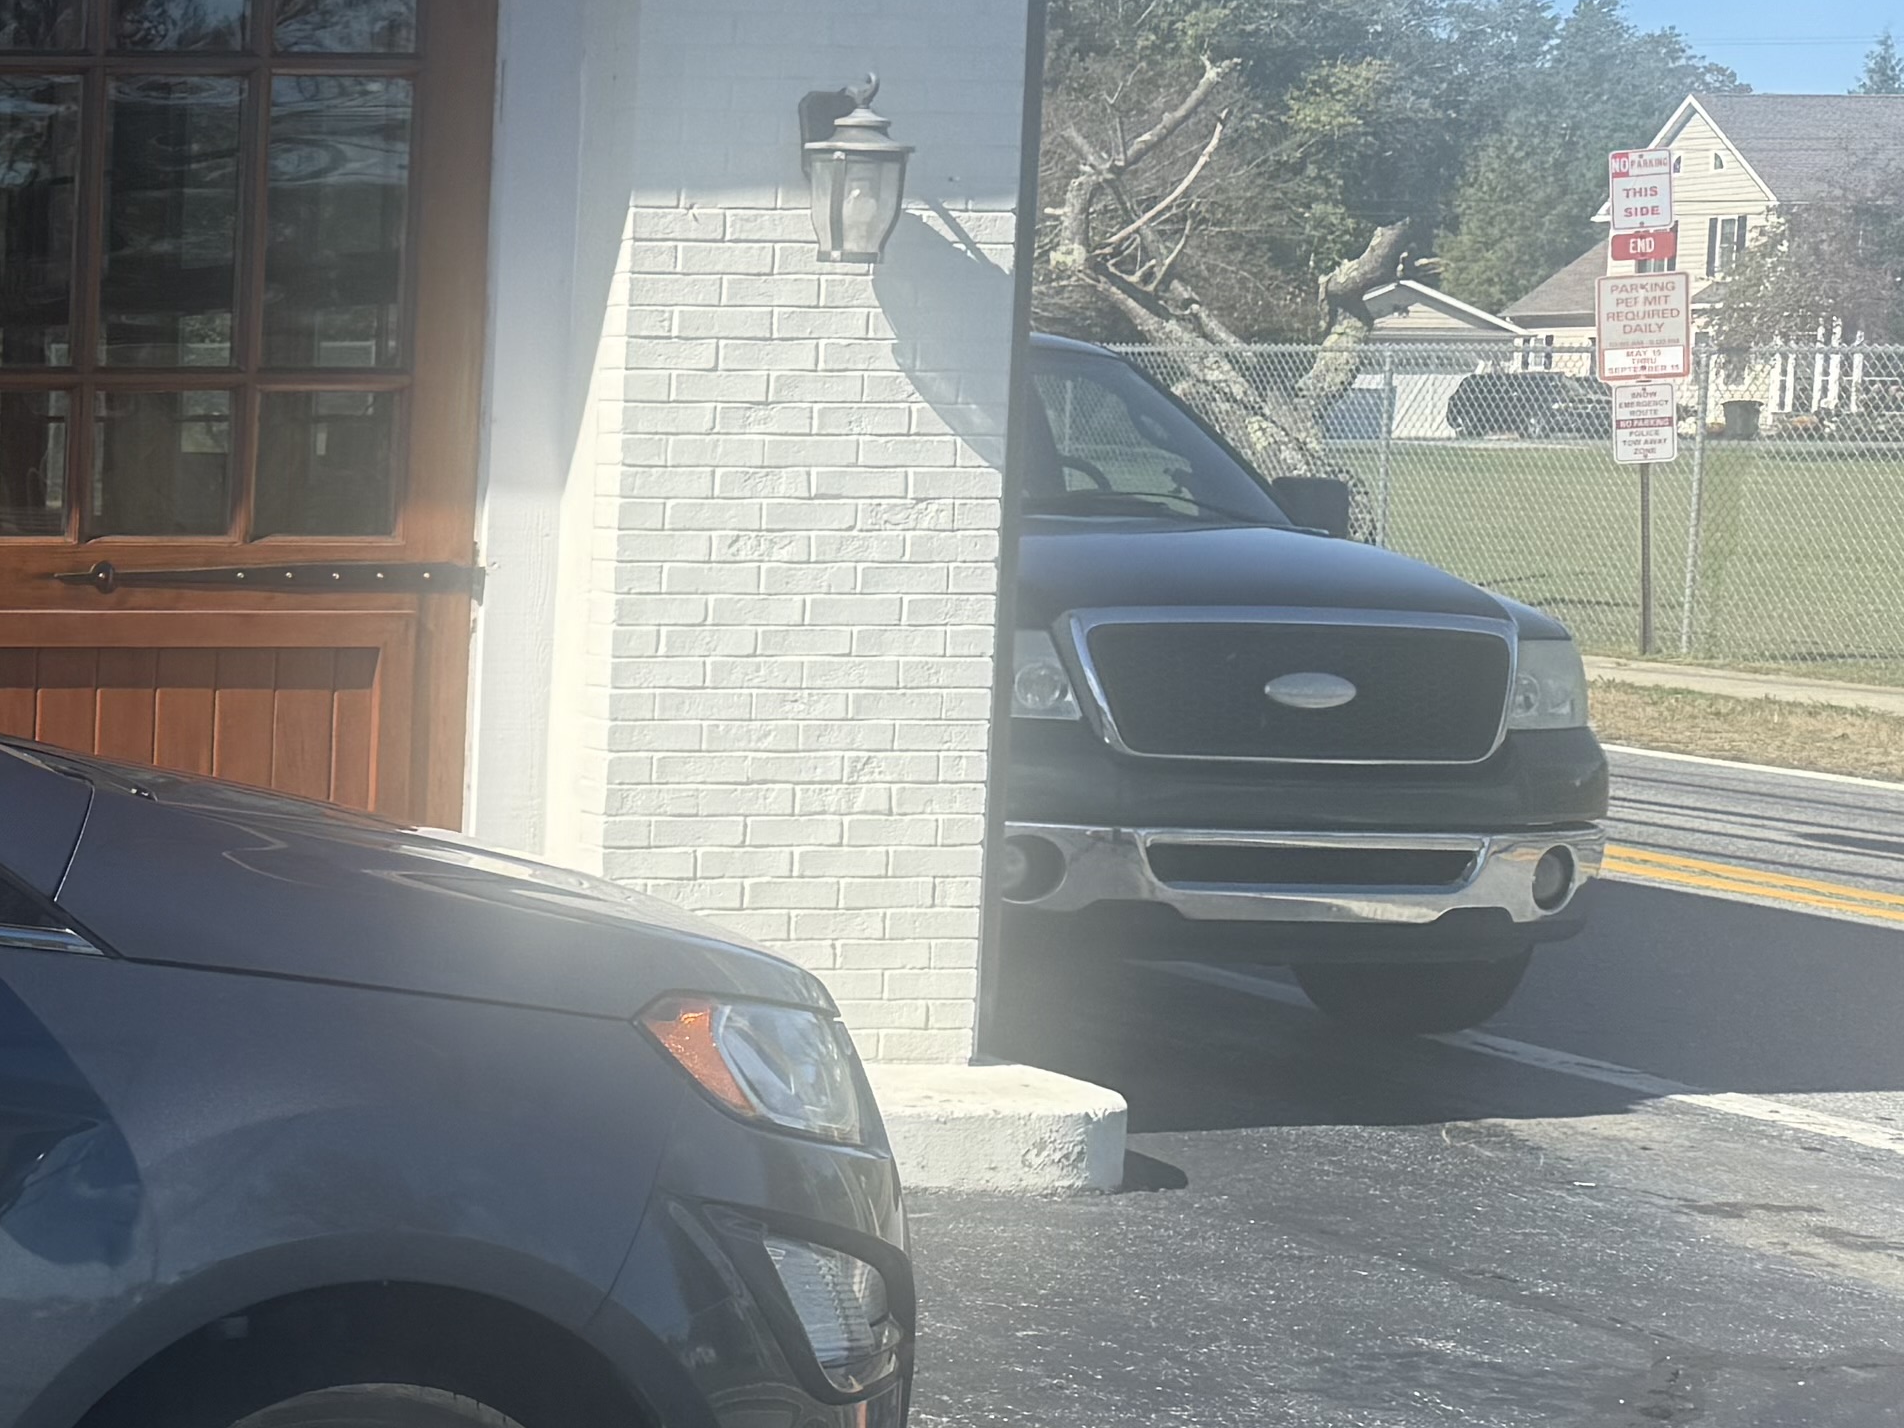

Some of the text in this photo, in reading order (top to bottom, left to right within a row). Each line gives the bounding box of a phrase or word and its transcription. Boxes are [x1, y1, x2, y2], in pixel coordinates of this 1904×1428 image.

[1612, 157, 1668, 173] NO PARKING
[1622, 186, 1659, 199] THIS
[1623, 206, 1661, 218] SIDE
[1629, 237, 1655, 254] END
[1610, 281, 1676, 294] PARKING
[1606, 308, 1681, 322] REQUIRED
[1622, 323, 1665, 335] DAILY
[1626, 350, 1648, 358] MAY
[1608, 365, 1667, 375] SEPTEBER
[1619, 400, 1669, 409] EMERGENCY
[1629, 409, 1659, 417] ROUTE
[1619, 418, 1670, 428] NO PARKING
